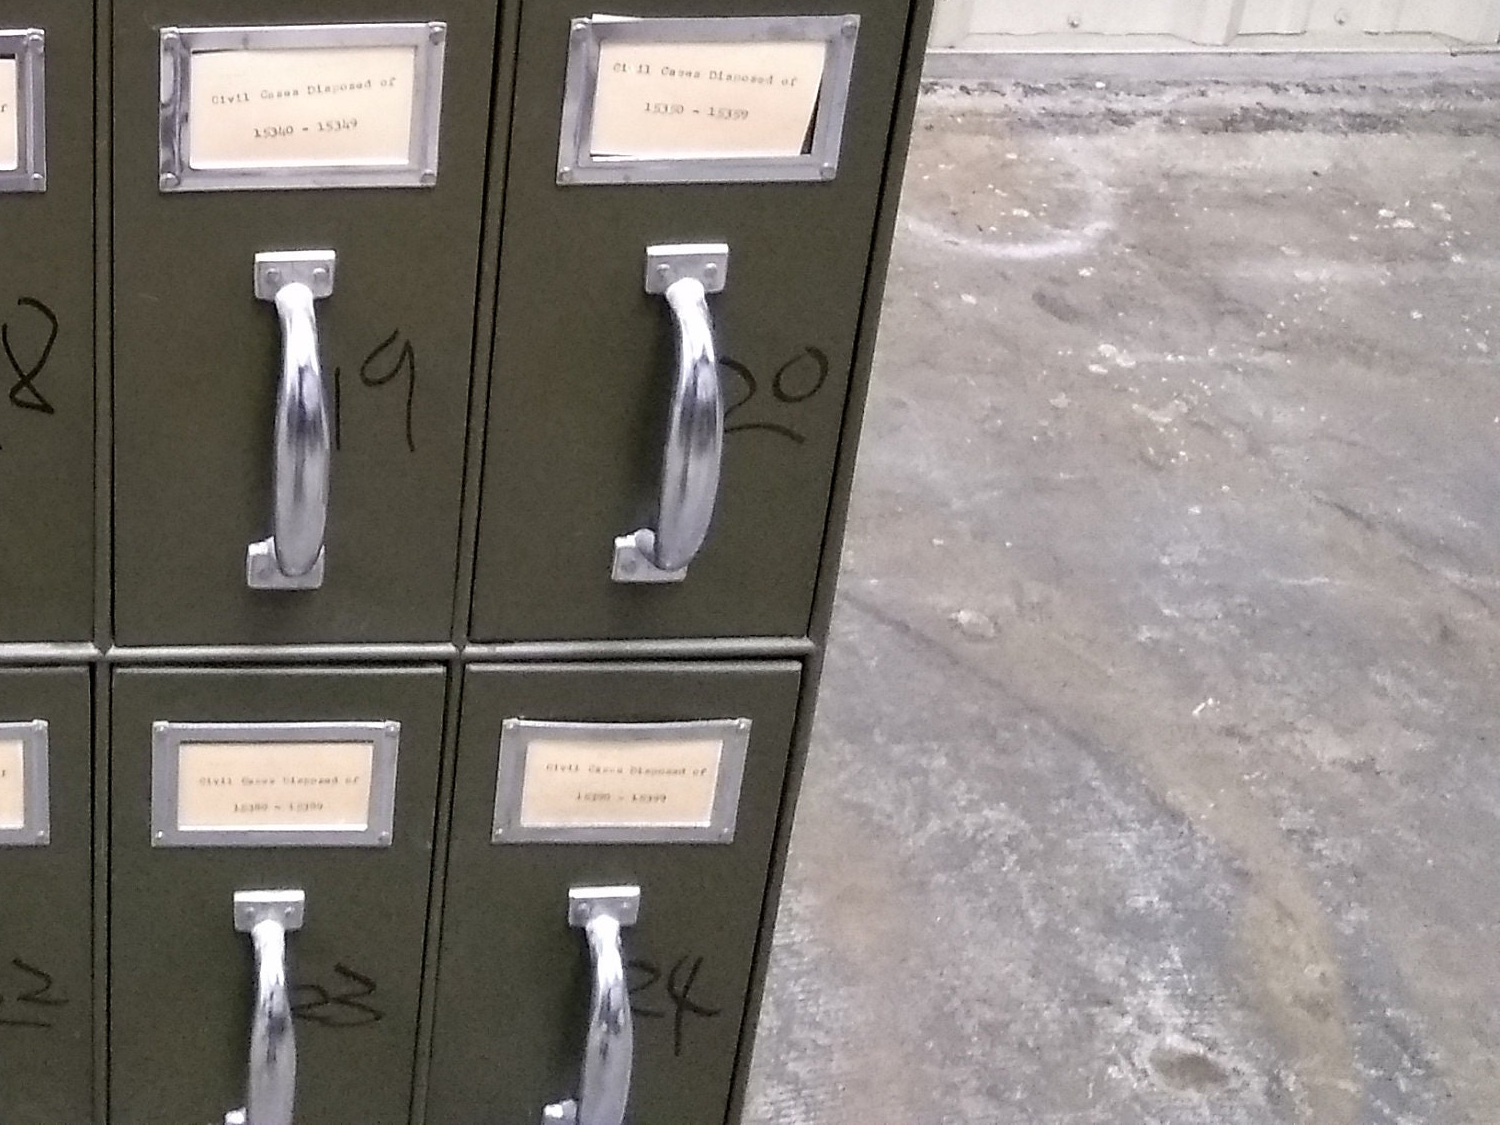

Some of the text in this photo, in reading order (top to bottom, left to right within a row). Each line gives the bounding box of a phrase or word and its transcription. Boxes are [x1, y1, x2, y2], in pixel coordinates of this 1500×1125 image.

[613, 62, 650, 74] Ciil
[661, 66, 700, 78] Cases
[781, 76, 797, 86] of
[212, 77, 396, 105] Civil Cases Disposed of
[708, 107, 749, 119] 15359
[254, 126, 294, 138] 15340
[318, 118, 358, 132] 15349
[335, 328, 416, 452] 19
[719, 345, 829, 444] 20
[628, 956, 721, 1057] 24
